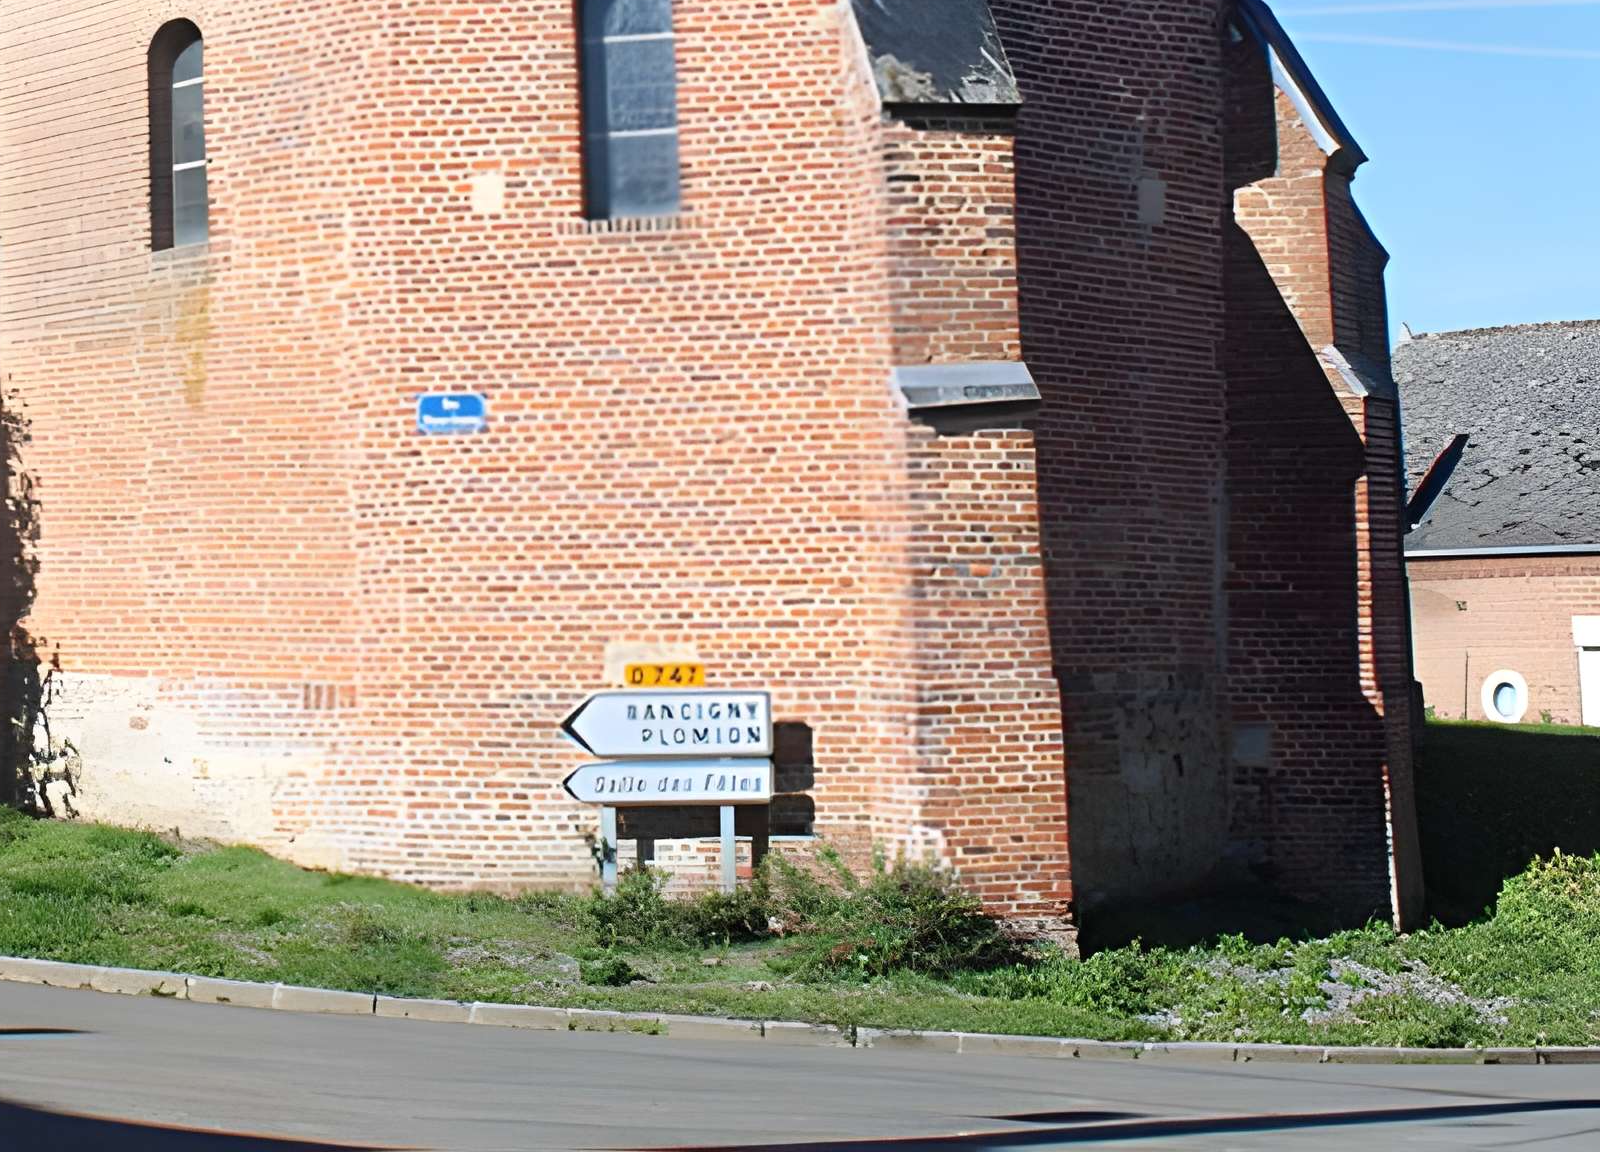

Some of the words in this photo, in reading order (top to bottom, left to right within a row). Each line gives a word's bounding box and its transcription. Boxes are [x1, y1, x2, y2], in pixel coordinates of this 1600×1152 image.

[632, 668, 644, 684] D
[654, 666, 697, 684] 747
[626, 702, 759, 721] BANCIGNY
[641, 726, 761, 746] PLOMION
